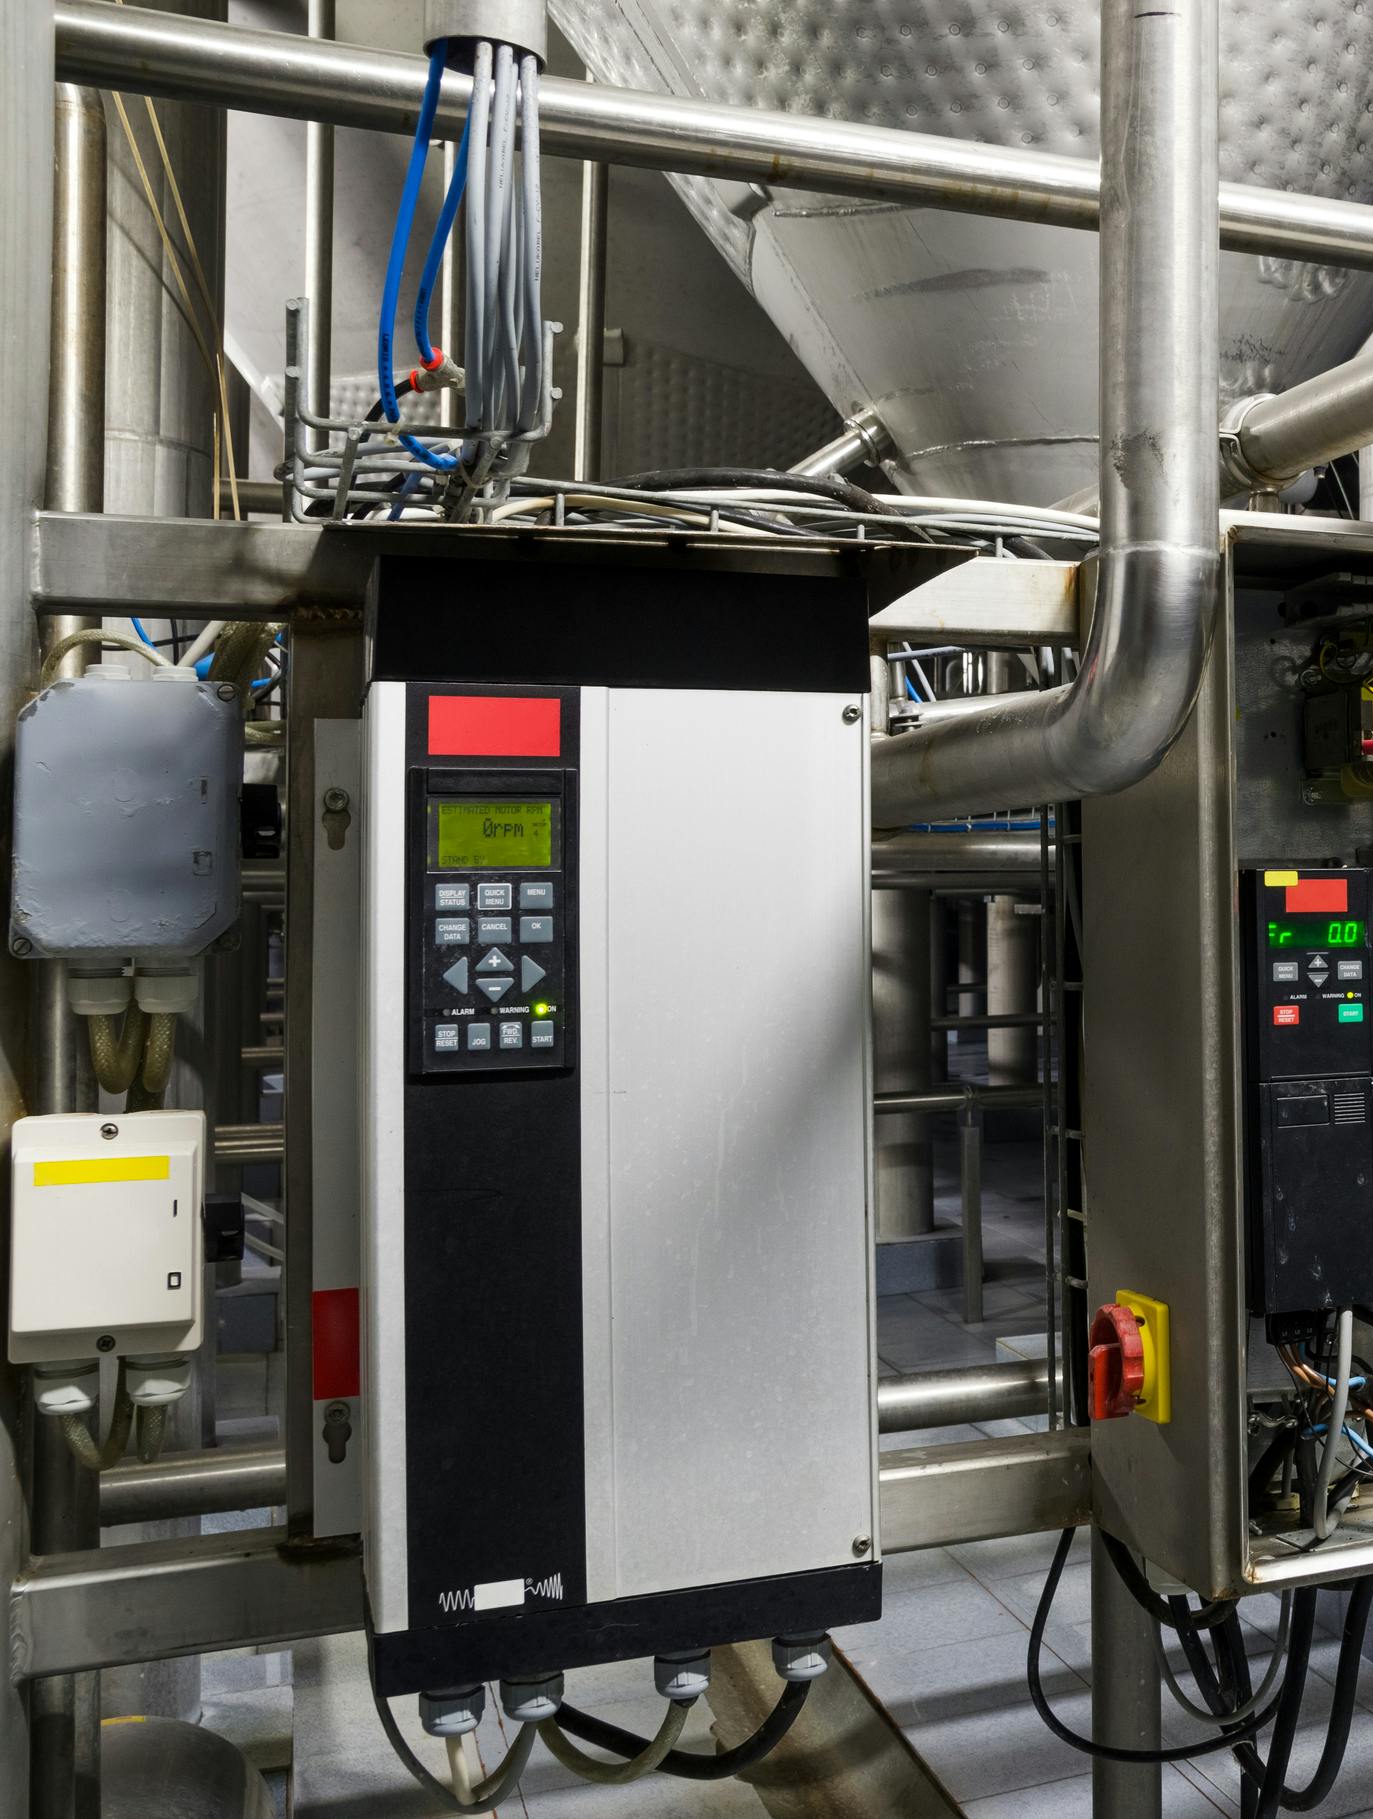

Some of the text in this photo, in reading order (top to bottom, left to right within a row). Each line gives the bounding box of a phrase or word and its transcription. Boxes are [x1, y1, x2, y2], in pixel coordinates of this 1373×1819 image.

[495, 805, 521, 815] MOTOR
[441, 855, 469, 865] STAND
[439, 889, 466, 897] DISPLAY
[484, 889, 505, 897] QUICK
[527, 888, 546, 896] MENU
[439, 898, 466, 906] STATUS
[438, 923, 467, 932] CHANGE
[481, 923, 508, 931] CANCEL
[531, 922, 542, 930] OK
[443, 933, 462, 941] DATA
[451, 1008, 476, 1016] ALARM
[499, 1006, 530, 1014] WARNING
[547, 1005, 557, 1013] ON
[437, 1030, 456, 1038] STOP
[435, 1039, 458, 1047] RESET
[471, 1038, 487, 1046] JOG
[531, 1035, 553, 1043] START
